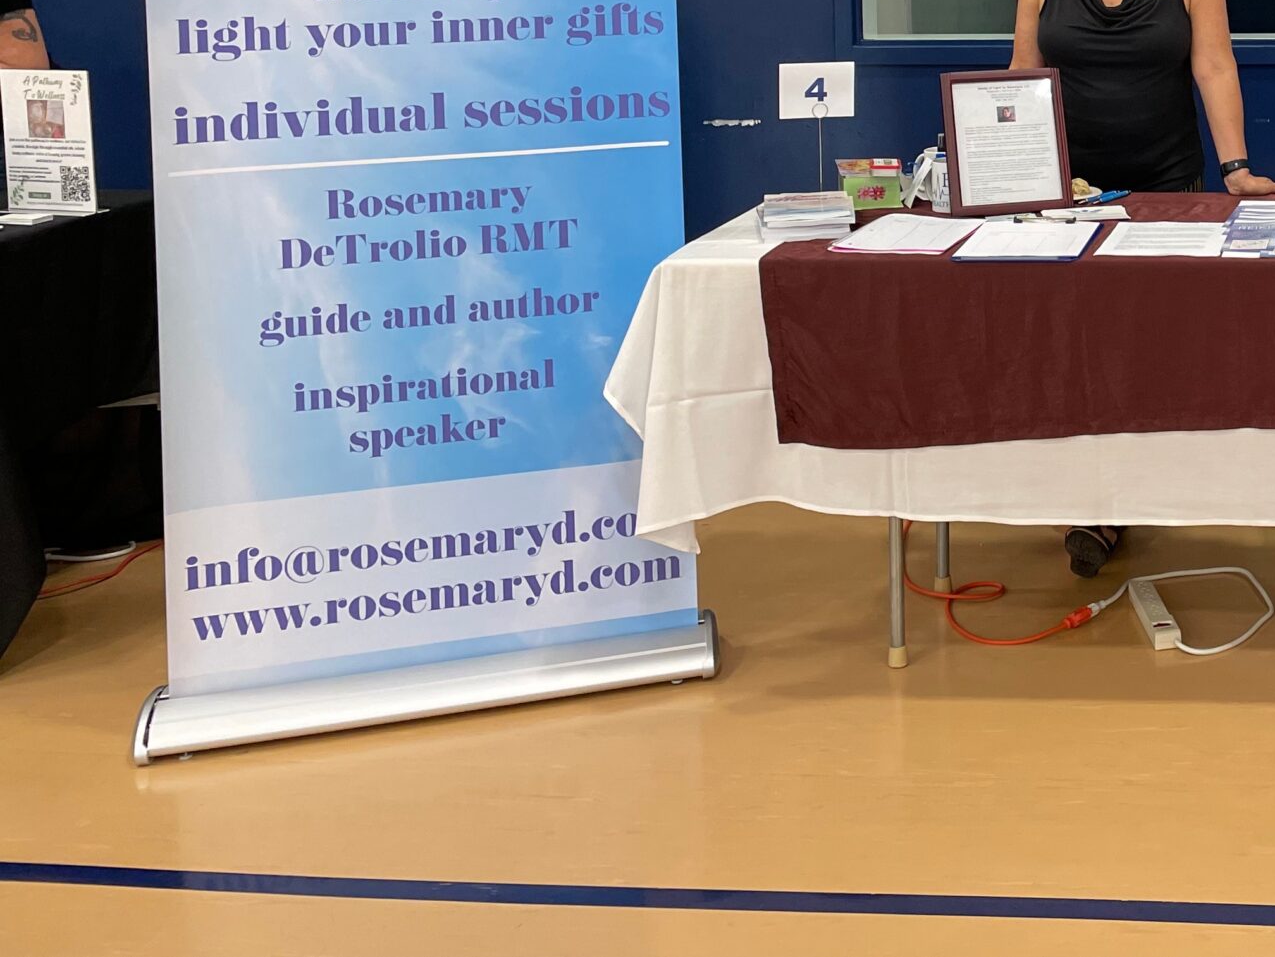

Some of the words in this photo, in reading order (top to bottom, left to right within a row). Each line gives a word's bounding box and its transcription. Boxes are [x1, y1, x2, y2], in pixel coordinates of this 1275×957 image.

[176, 16, 290, 61] light
[307, 21, 417, 56] your
[432, 10, 554, 44] inner
[566, 2, 664, 46] gifts
[173, 92, 448, 145] individual
[464, 86, 670, 128] sessions
[804, 77, 828, 102] 4
[326, 185, 532, 222] Rosemary
[279, 229, 467, 270] DeTrolio
[481, 218, 578, 254] RMT
[259, 303, 372, 347] guide
[382, 294, 456, 329] and
[468, 287, 600, 322] author
[294, 358, 555, 413] inspirational
[350, 413, 506, 458] speaker
[185, 508, 637, 591] info@rosemaryd.co
[191, 554, 682, 641] www.rosemaryd.com
